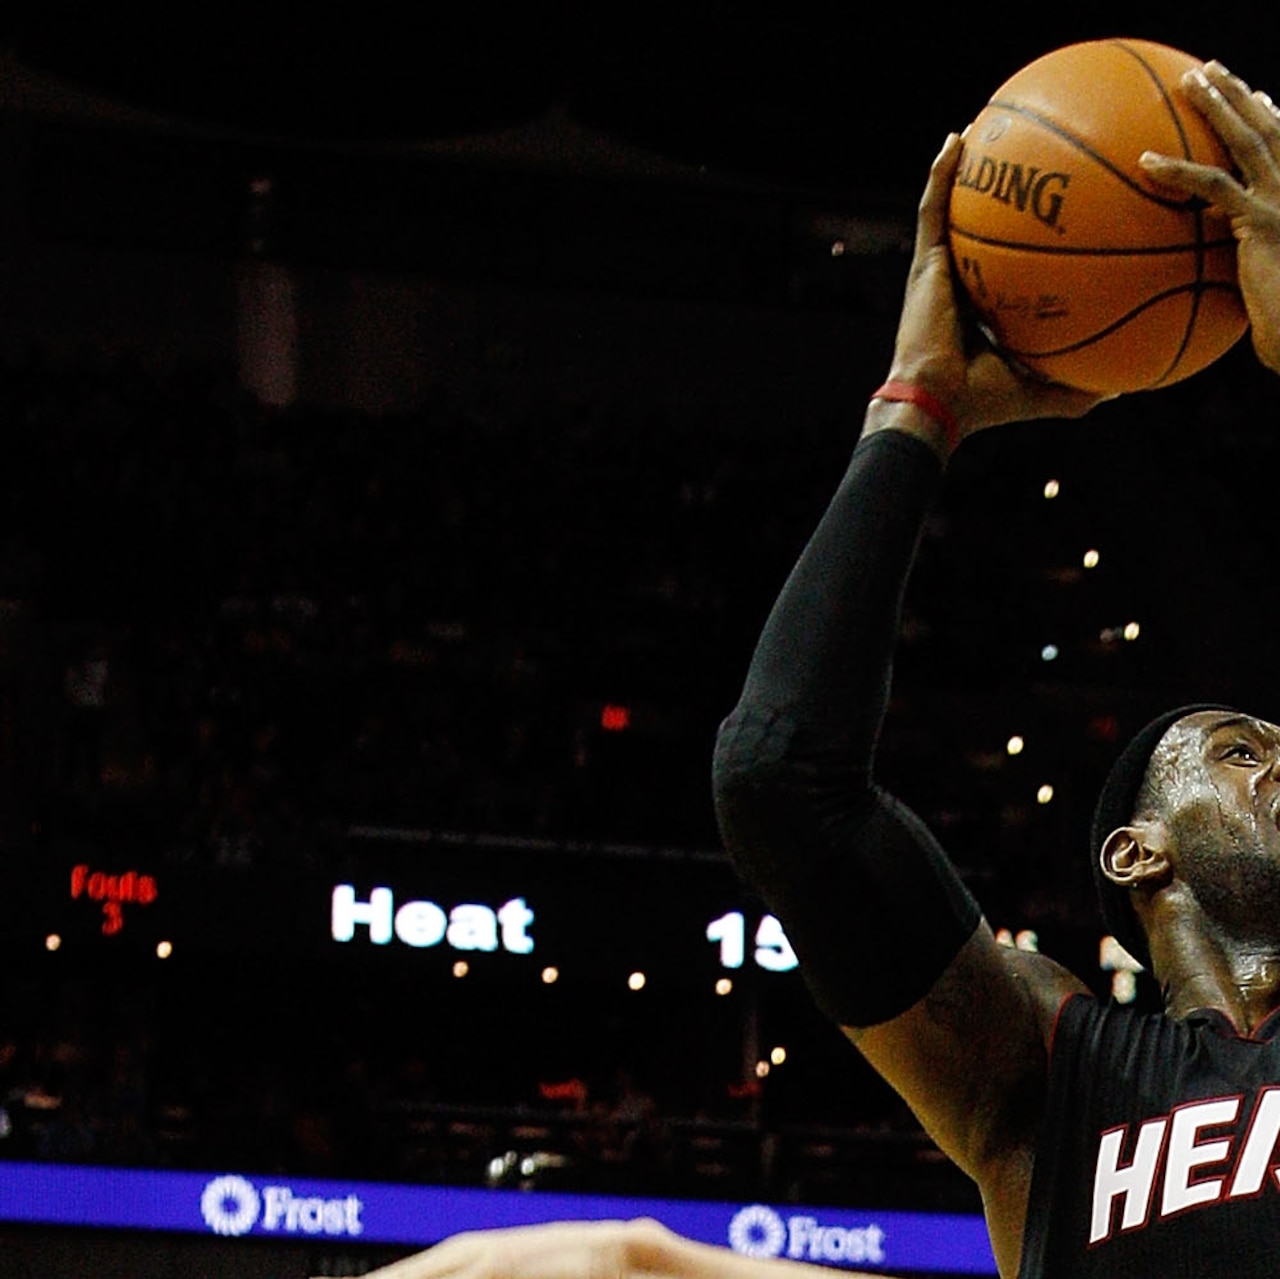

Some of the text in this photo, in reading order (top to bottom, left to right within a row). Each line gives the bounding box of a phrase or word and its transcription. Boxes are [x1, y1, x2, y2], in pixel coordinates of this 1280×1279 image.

[955, 155, 1071, 236] LDING
[331, 883, 535, 955] Heat
[706, 911, 799, 972] 15
[263, 1186, 363, 1236] Frost
[787, 1215, 885, 1264] Frost
